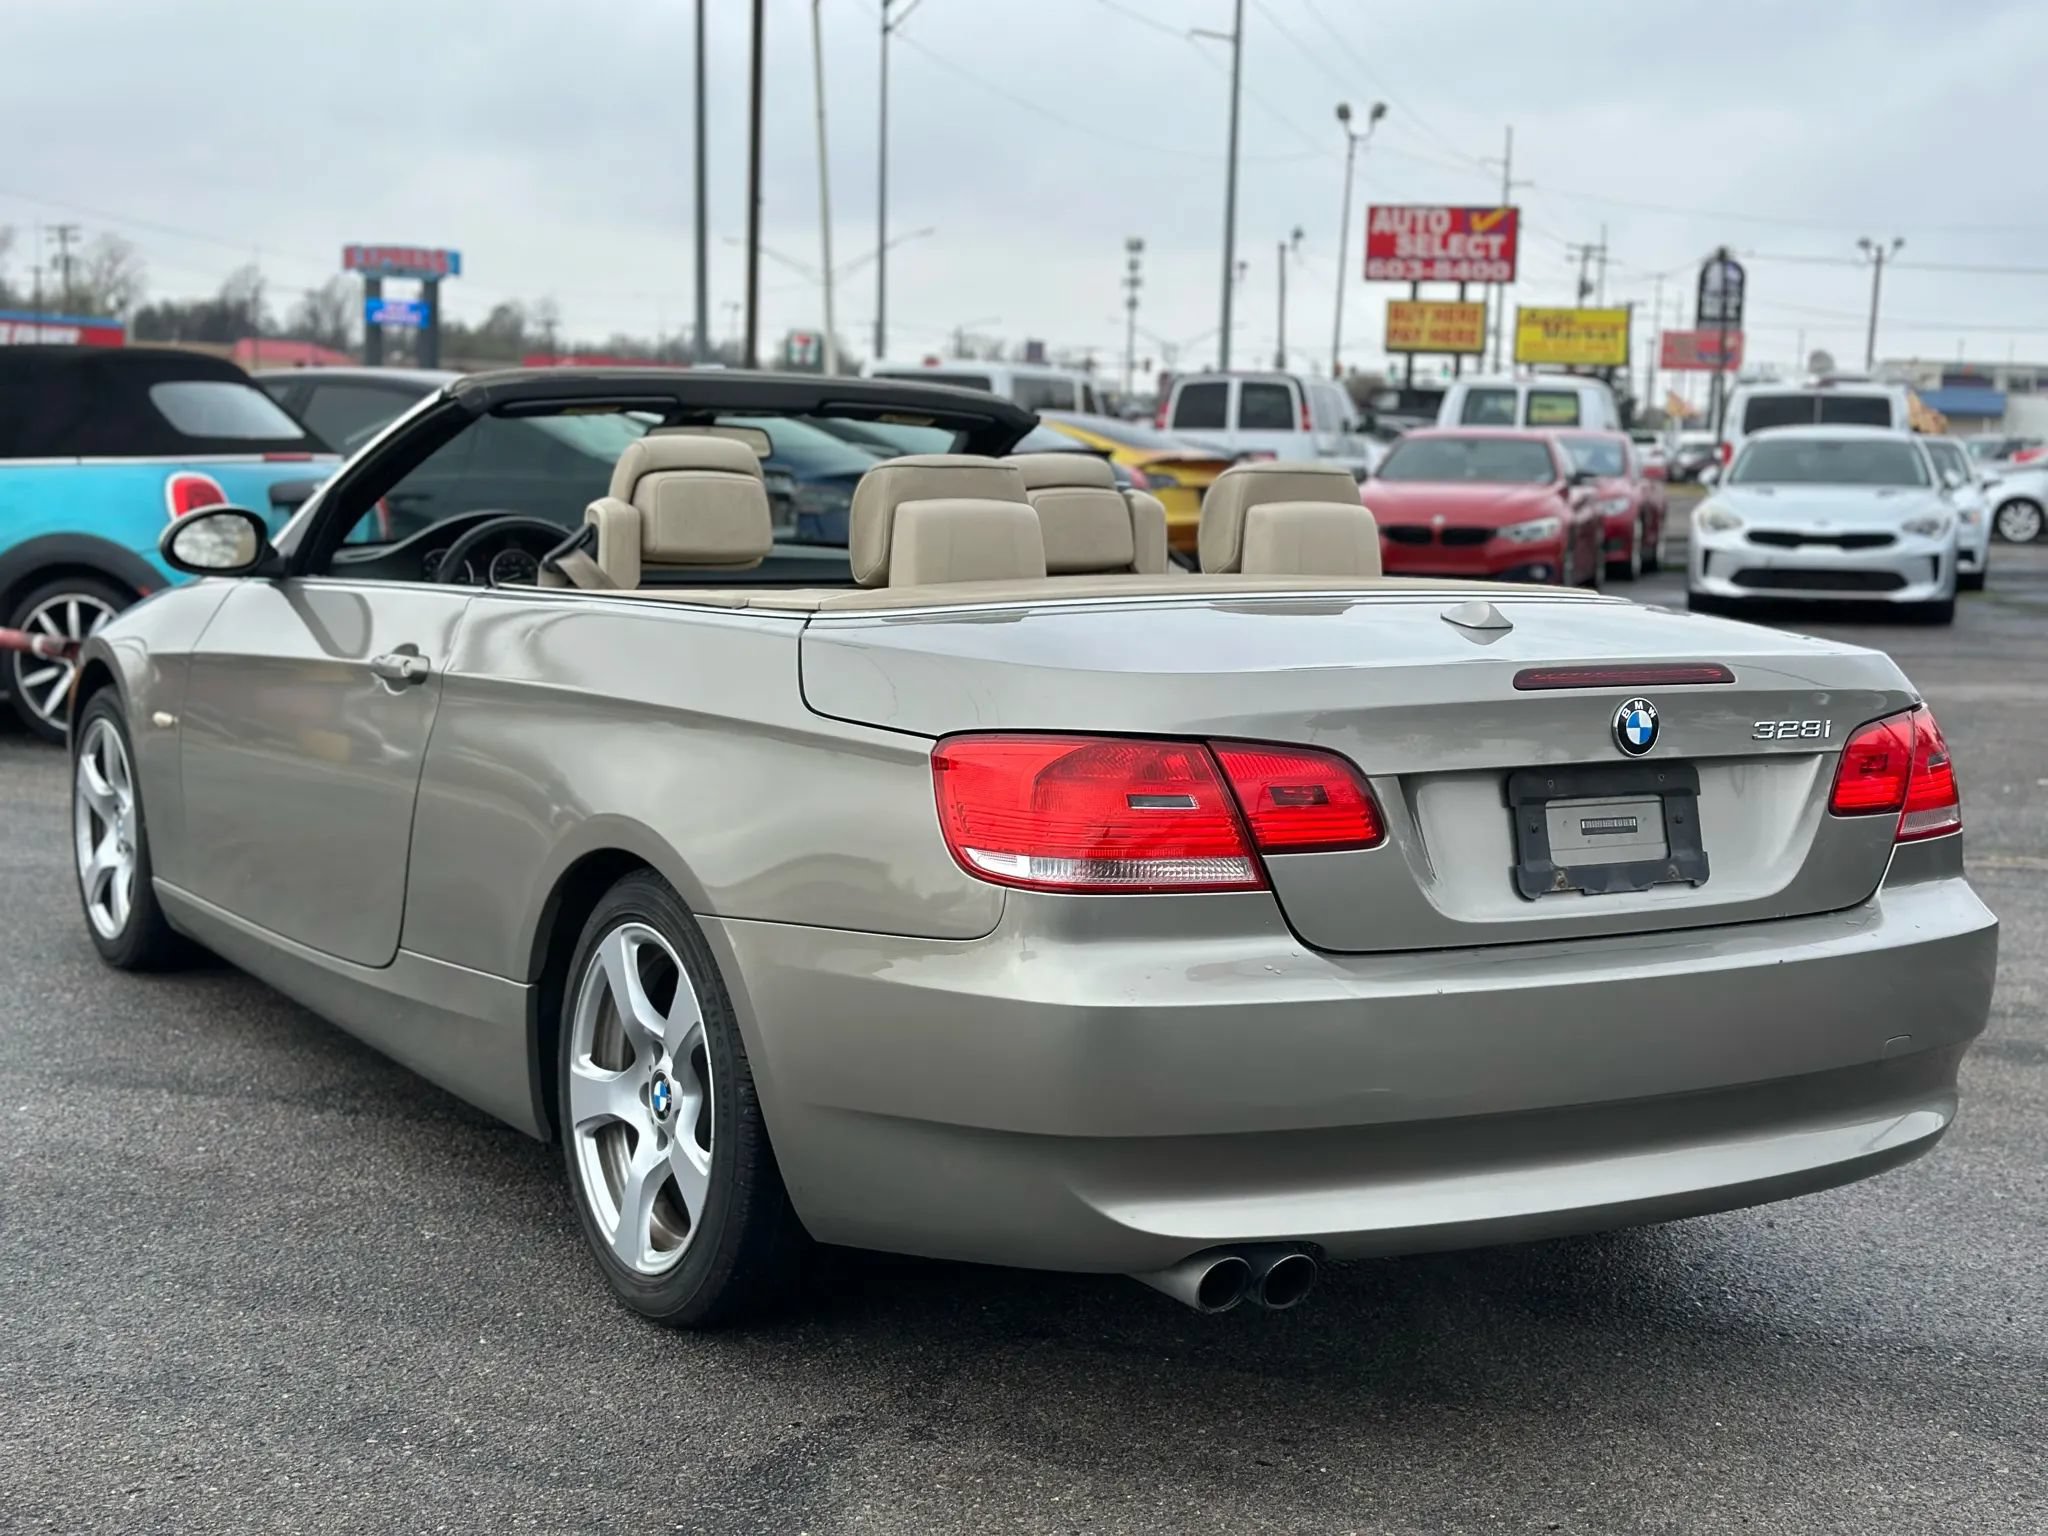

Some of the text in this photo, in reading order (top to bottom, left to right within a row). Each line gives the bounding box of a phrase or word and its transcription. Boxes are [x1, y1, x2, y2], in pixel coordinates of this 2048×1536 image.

[1371, 206, 1452, 235] AUTO
[1395, 233, 1507, 260] SELECT
[1366, 257, 1512, 281] 603-8400
[1391, 305, 1480, 324] BUY HERE
[1389, 327, 1477, 345] PAY HERE
[1621, 700, 1657, 720] BMW
[1751, 719, 1832, 741] 328i
